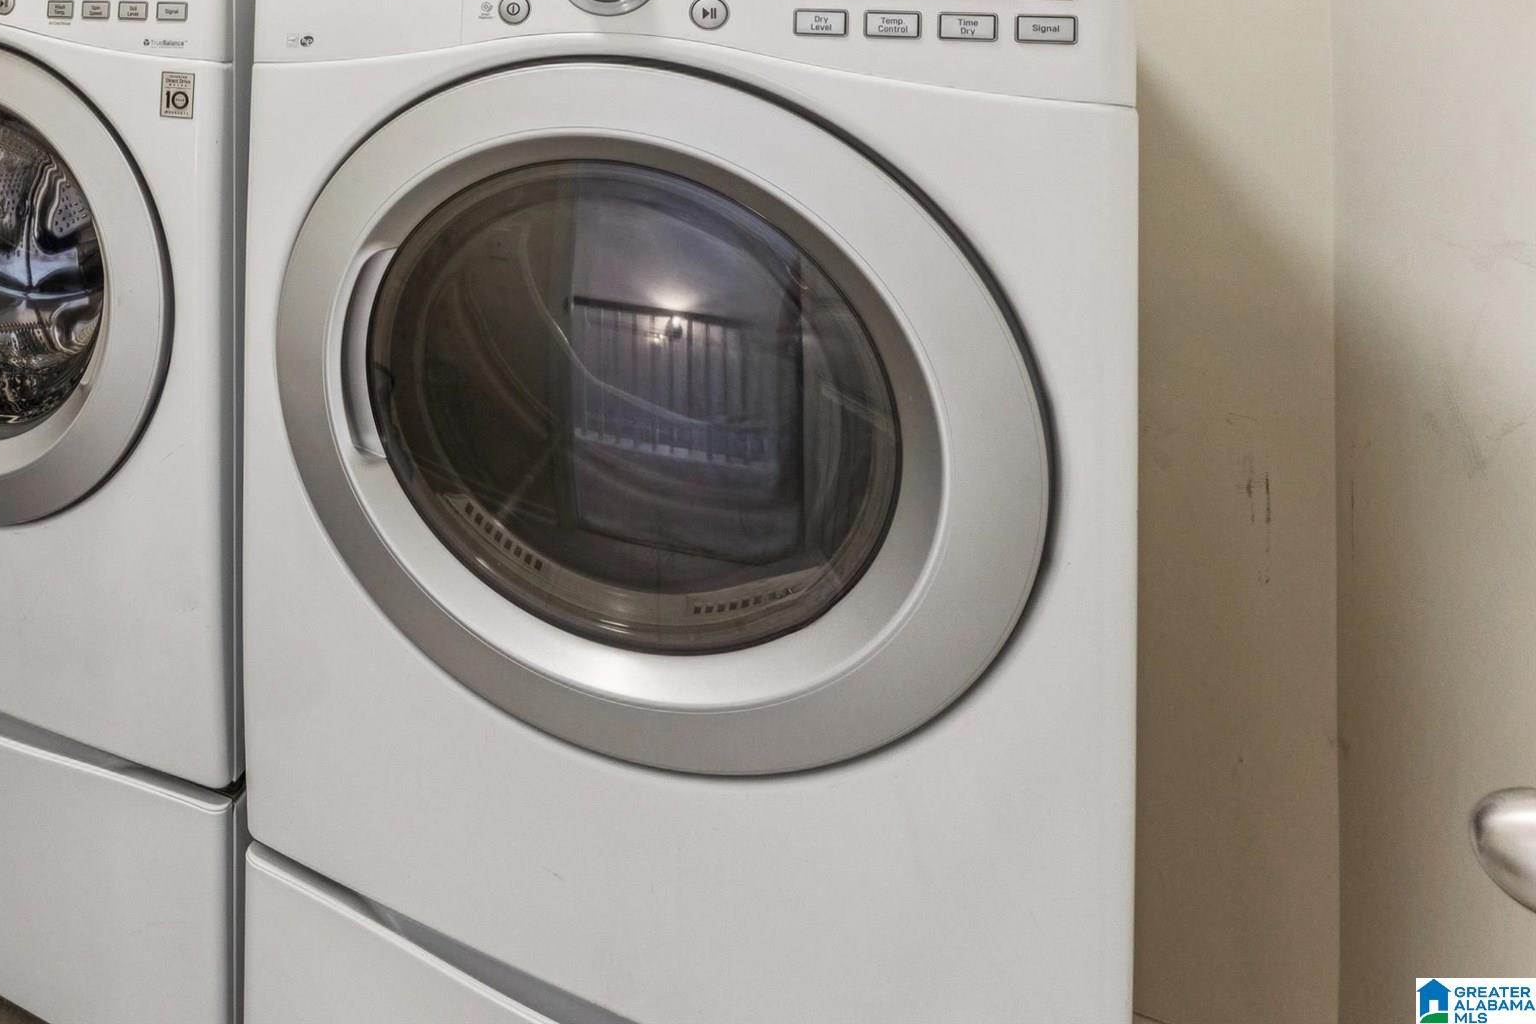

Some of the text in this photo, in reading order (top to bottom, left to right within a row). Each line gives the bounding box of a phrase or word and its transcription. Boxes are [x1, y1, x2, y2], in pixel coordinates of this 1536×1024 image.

[814, 15, 829, 24] Dry
[957, 18, 979, 27] Time
[810, 23, 833, 32] Level
[877, 25, 909, 33] Control
[960, 27, 976, 36] Dry
[1031, 23, 1061, 34] Signal
[165, 90, 190, 110] 10
